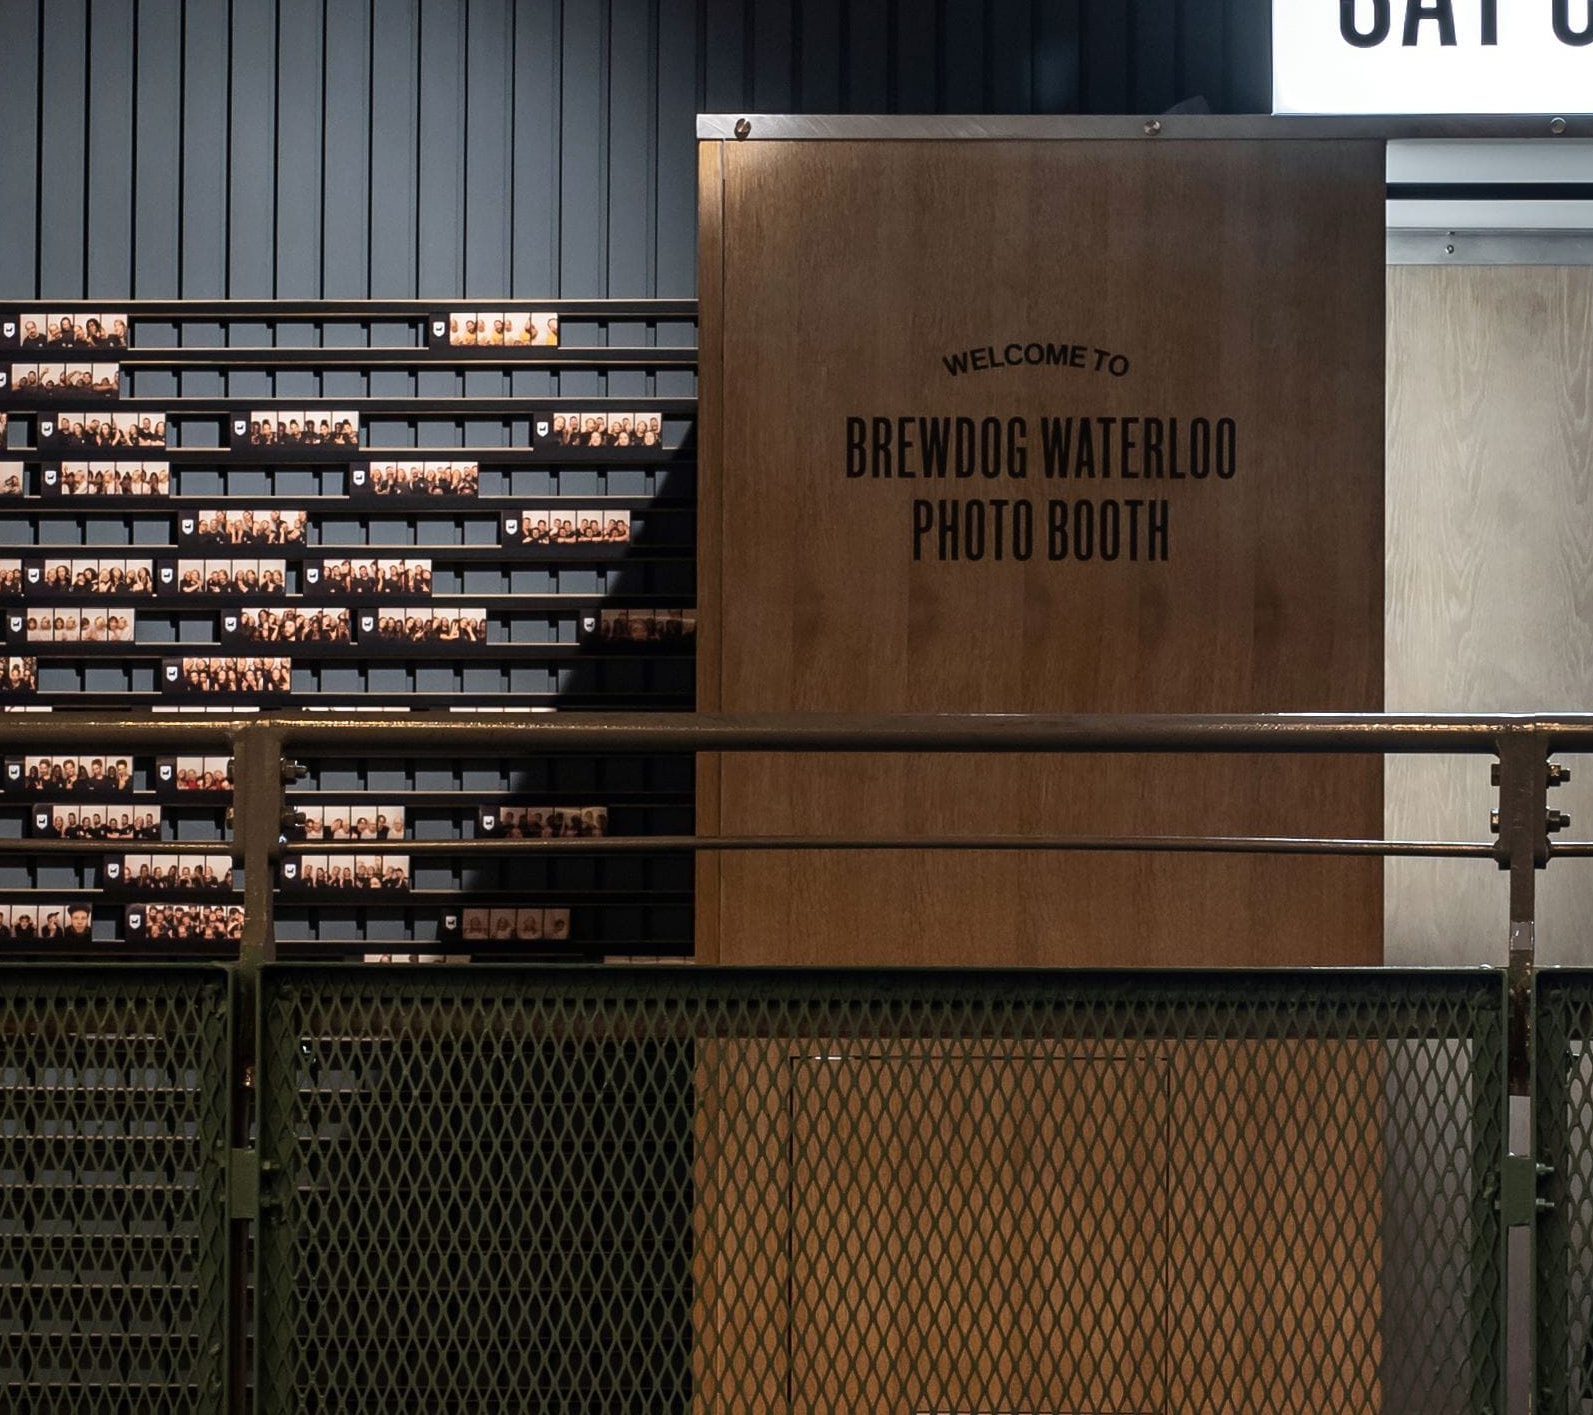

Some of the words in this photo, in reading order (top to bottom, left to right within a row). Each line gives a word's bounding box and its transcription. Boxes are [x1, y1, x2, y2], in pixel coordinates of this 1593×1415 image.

[942, 342, 1087, 377] WELCOME
[1093, 348, 1130, 377] TO
[846, 416, 1028, 479] BREWDOG
[1041, 416, 1237, 479] WATERLOO
[913, 499, 1034, 562] PHOTO
[1048, 499, 1170, 562] BOOTH
